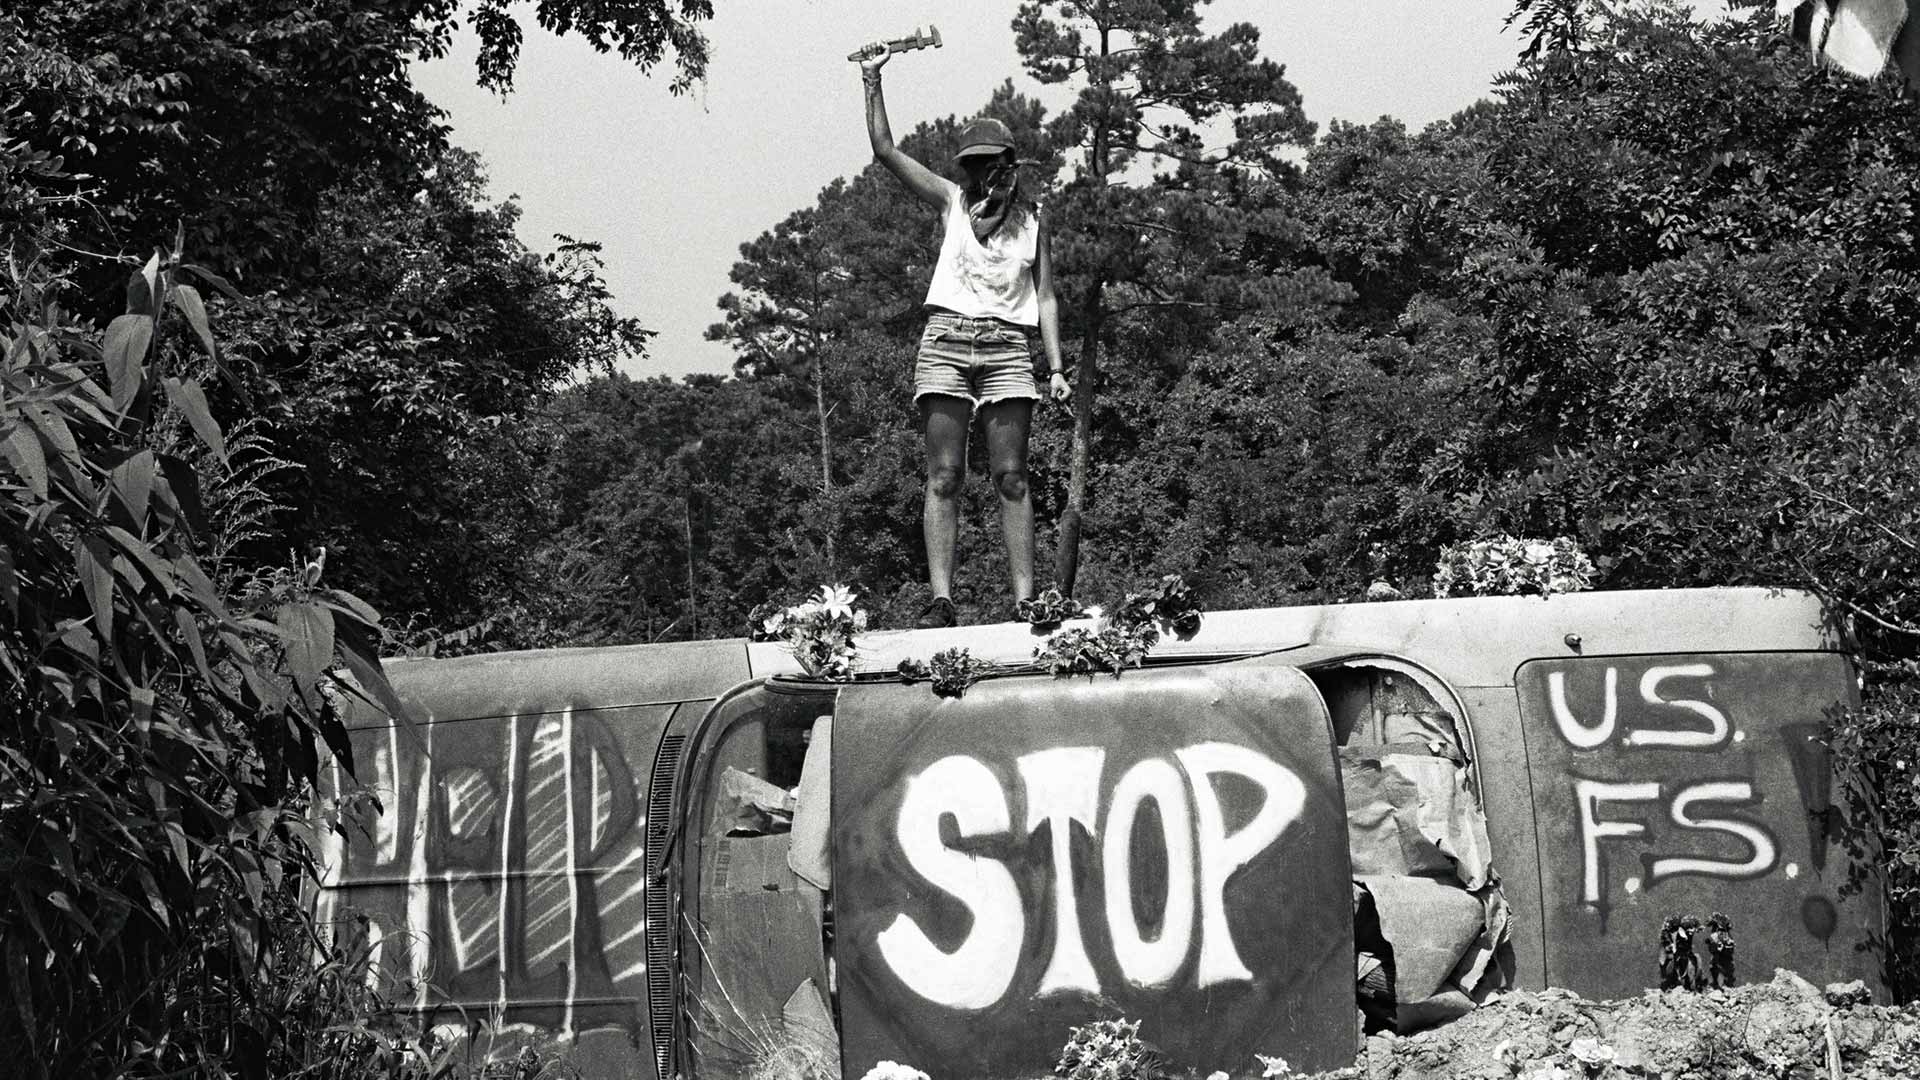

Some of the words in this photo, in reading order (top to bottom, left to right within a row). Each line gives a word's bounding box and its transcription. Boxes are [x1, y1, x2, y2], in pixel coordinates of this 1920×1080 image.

[1549, 663, 1745, 748] U.S.
[877, 740, 1307, 1010] STOP
[1574, 780, 1799, 903] F.S.
